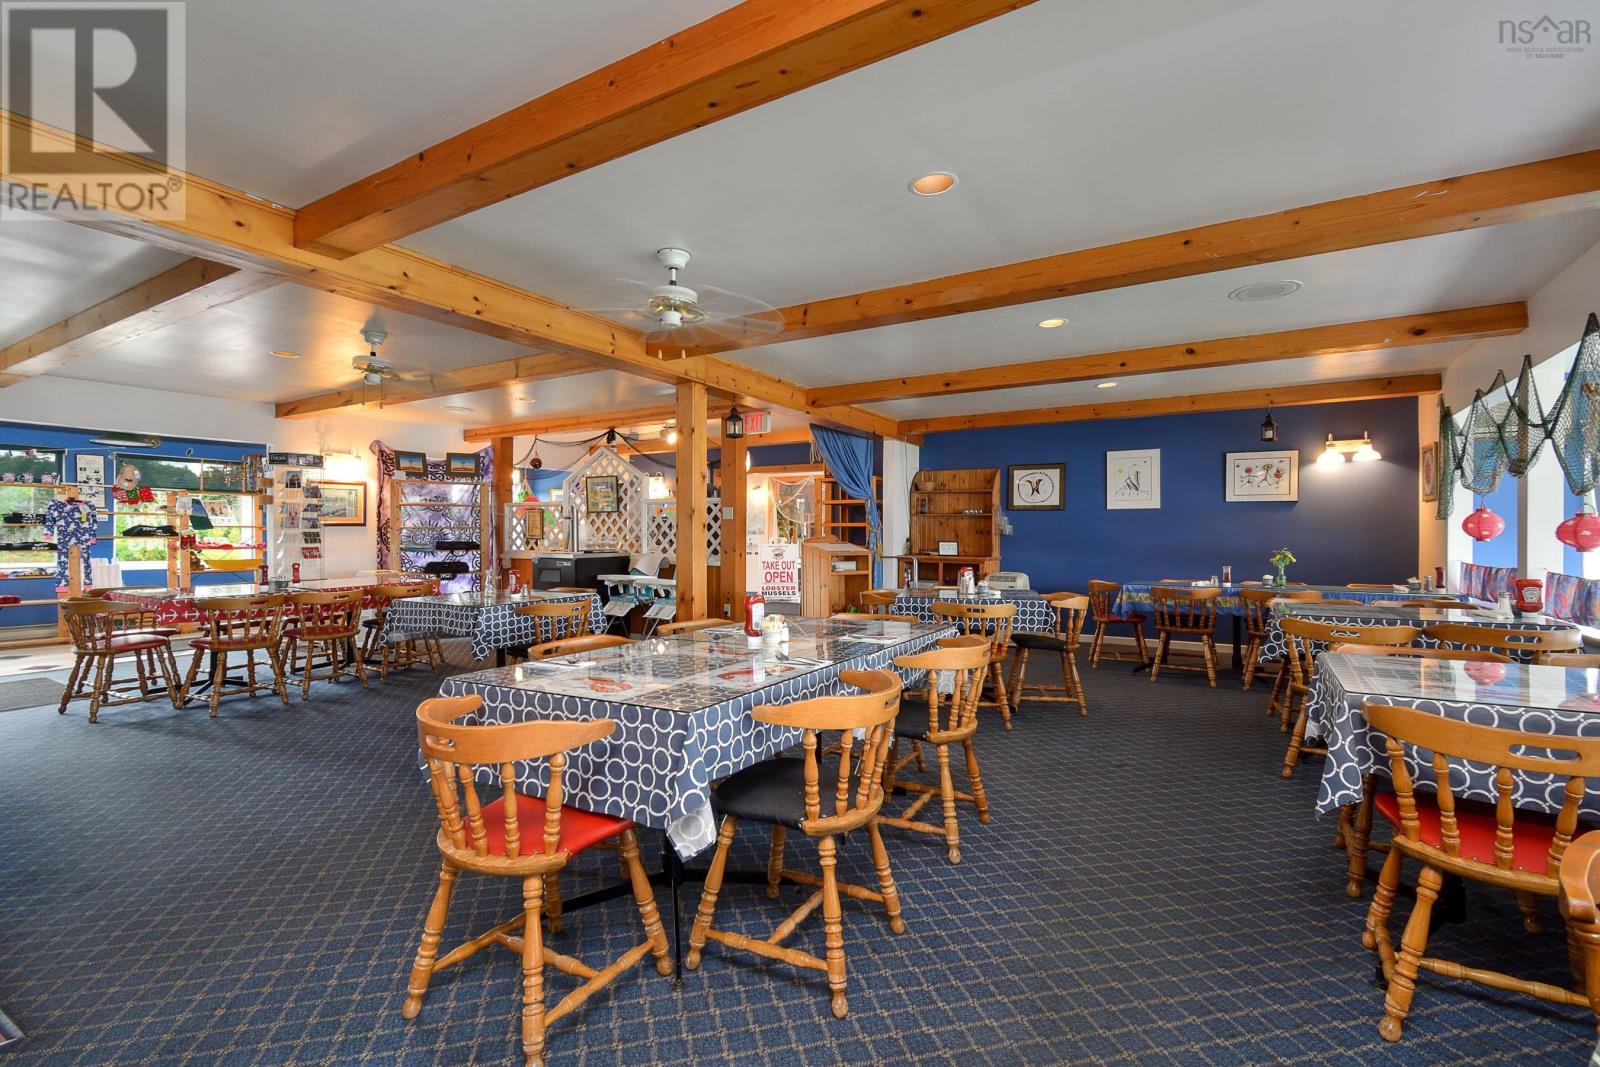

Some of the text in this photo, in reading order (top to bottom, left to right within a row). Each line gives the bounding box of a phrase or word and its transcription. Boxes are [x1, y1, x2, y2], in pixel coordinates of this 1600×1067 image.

[744, 413, 764, 432] EXIT
[761, 560, 796, 570] TAKE OUT
[764, 571, 794, 583] OPEN
